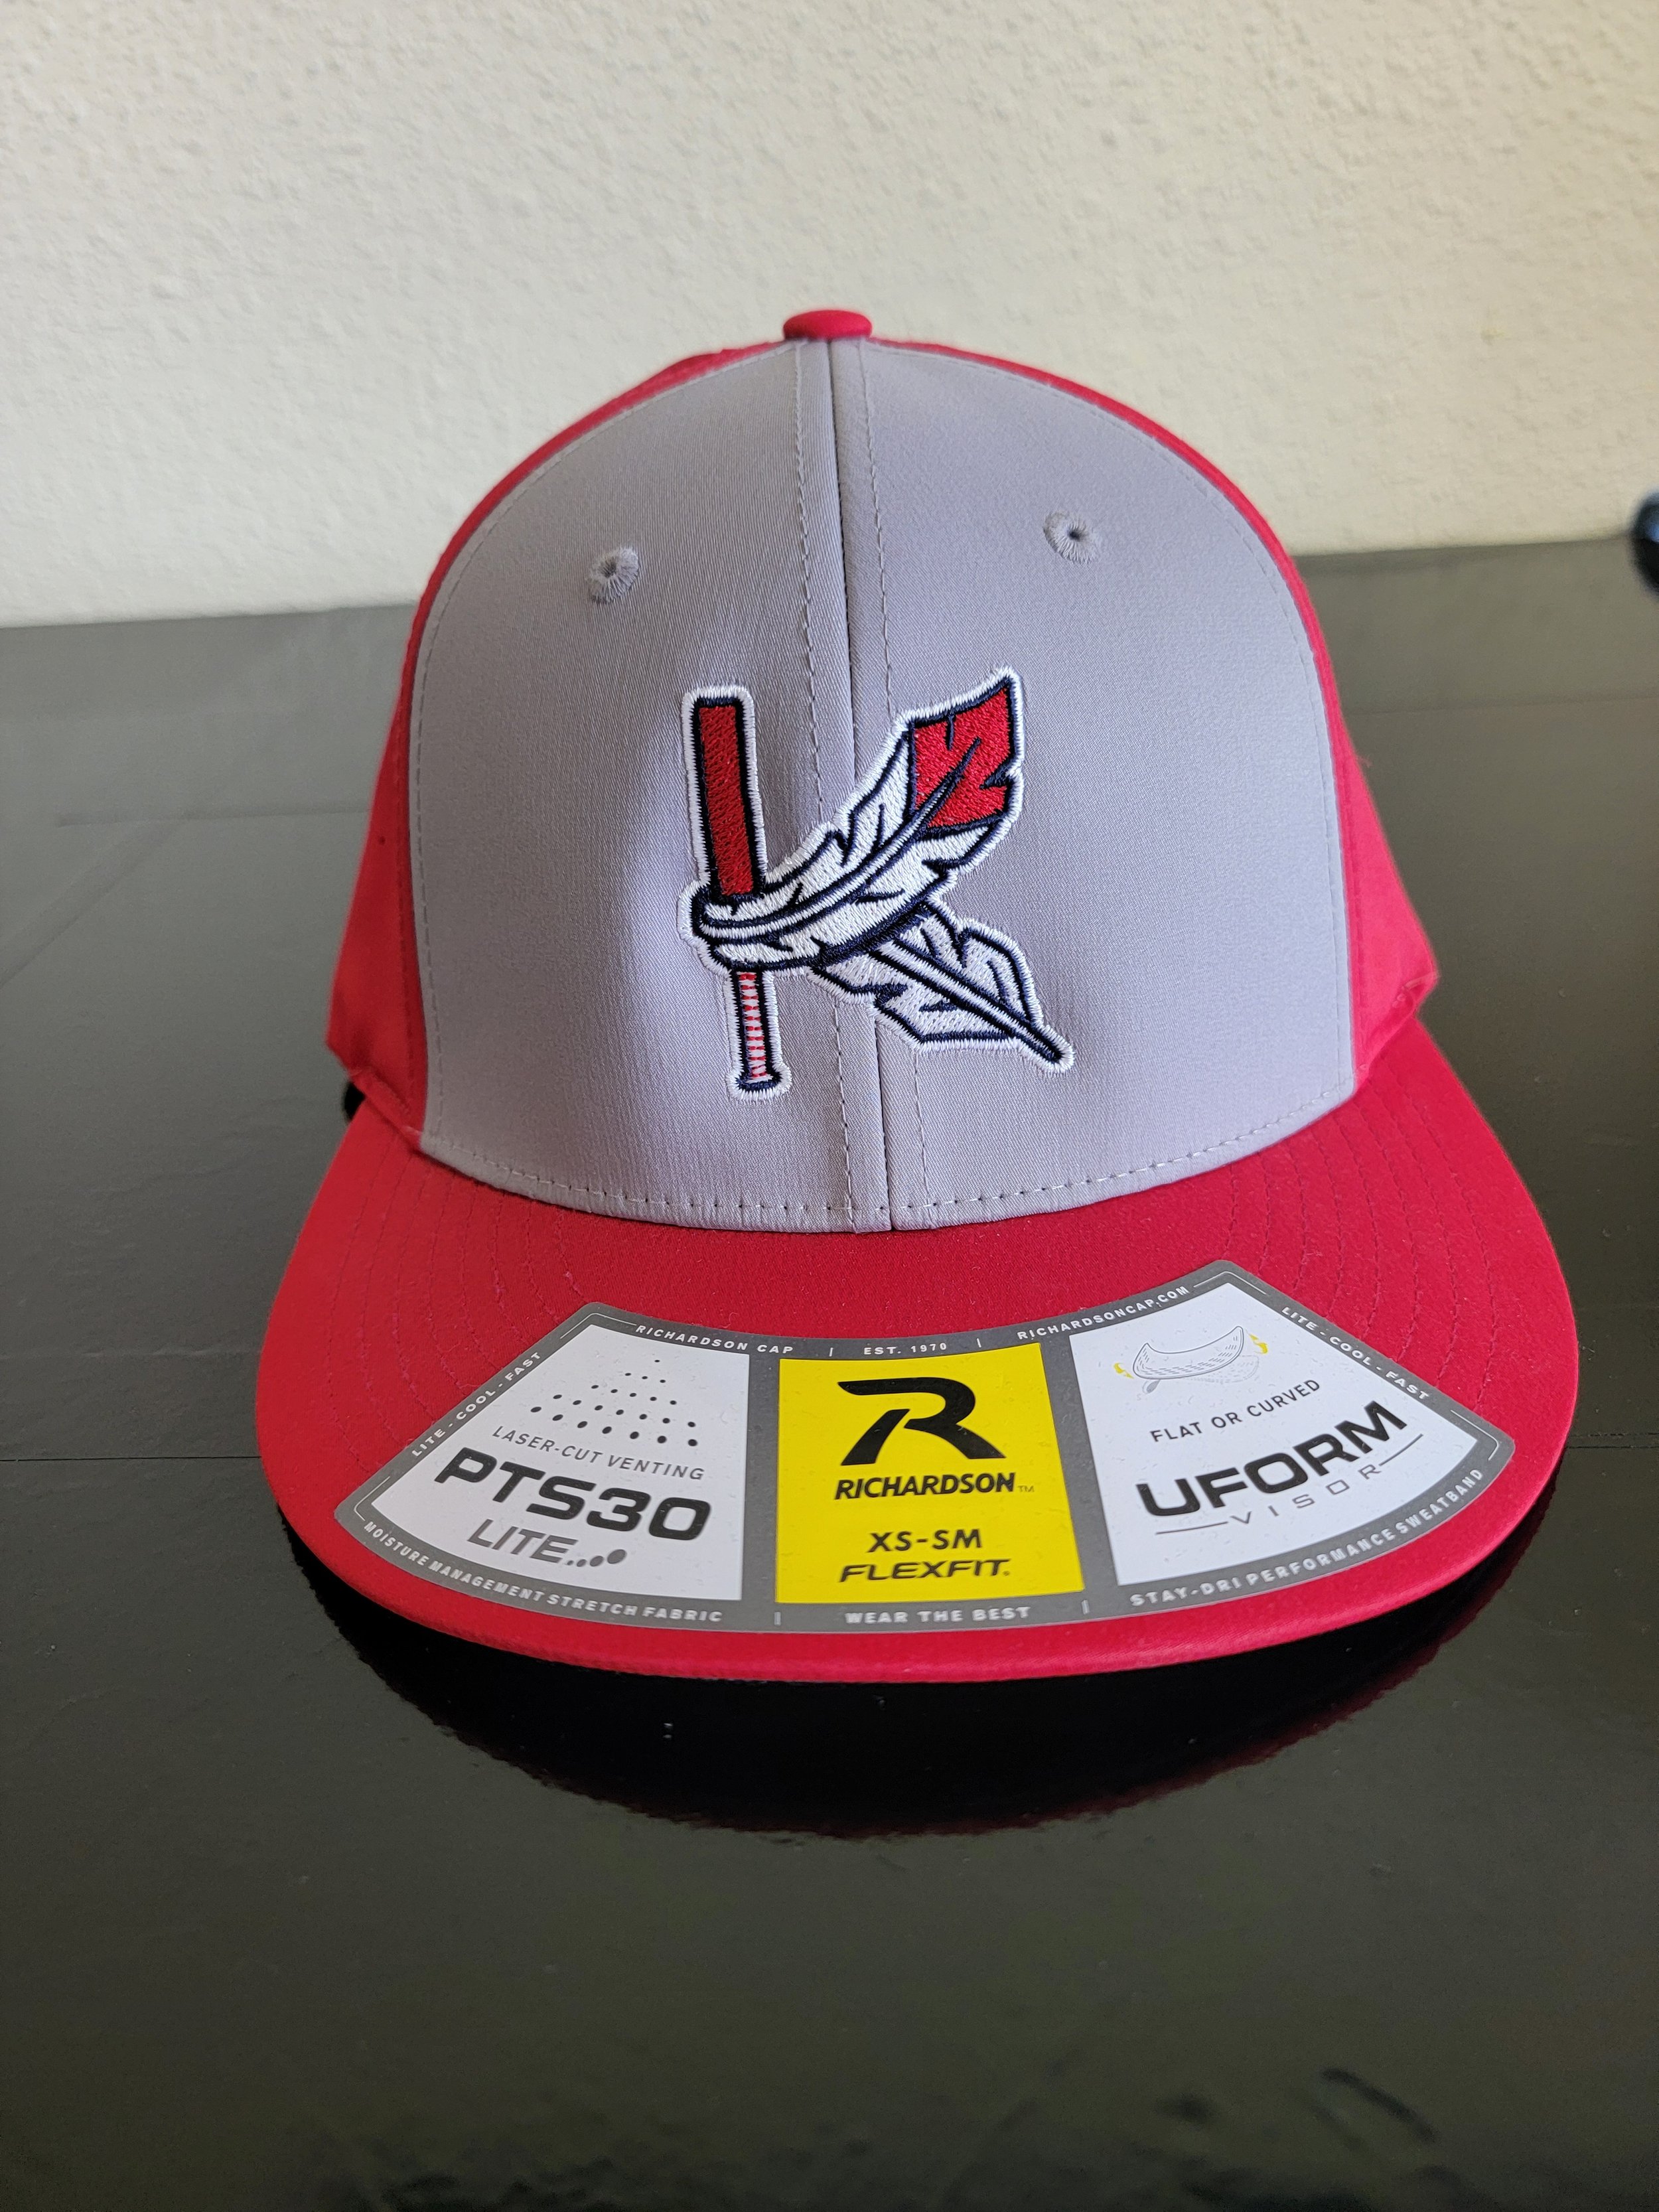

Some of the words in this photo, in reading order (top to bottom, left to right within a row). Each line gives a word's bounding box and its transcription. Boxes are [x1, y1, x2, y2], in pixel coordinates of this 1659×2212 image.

[636, 1324, 748, 1351] RICHARDSON
[757, 1345, 794, 1355] CAP
[1017, 1286, 1190, 1340] RICHARDSONCAP.COM
[863, 1347, 901, 1355] EST.
[910, 1342, 948, 1353] 1970
[1281, 1306, 1317, 1330] LITE
[1331, 1335, 1372, 1367] COOL
[1386, 1371, 1430, 1400] FAST
[412, 1429, 445, 1457] LITE
[456, 1388, 496, 1422] COOL
[505, 1351, 541, 1382] FAST
[1149, 1422, 1204, 1443] FLAT
[1211, 1412, 1243, 1428] OR
[1247, 1378, 1321, 1417] CURVED
[492, 1425, 603, 1463] LASER-CUT
[607, 1455, 704, 1481] VENTING
[1136, 1400, 1407, 1517] UFORM
[433, 1447, 711, 1541] PTS30
[835, 1473, 1016, 1500] RICHARDSON
[1230, 1463, 1382, 1526] VISOR
[867, 1529, 983, 1553] XS-SM
[1130, 1577, 1240, 1606] STAY-DRI
[1246, 1528, 1396, 1584] PERFORMANCE
[1395, 1468, 1484, 1534] SWEATBAND
[363, 1520, 427, 1567] MOISTURE
[429, 1559, 543, 1601] MANAGEMENT
[547, 1593, 636, 1617] STRETCH
[641, 1609, 723, 1622] FABRIC
[845, 1612, 908, 1624] WEAR
[918, 1610, 964, 1621] THE
[972, 1606, 1031, 1619] BEST
